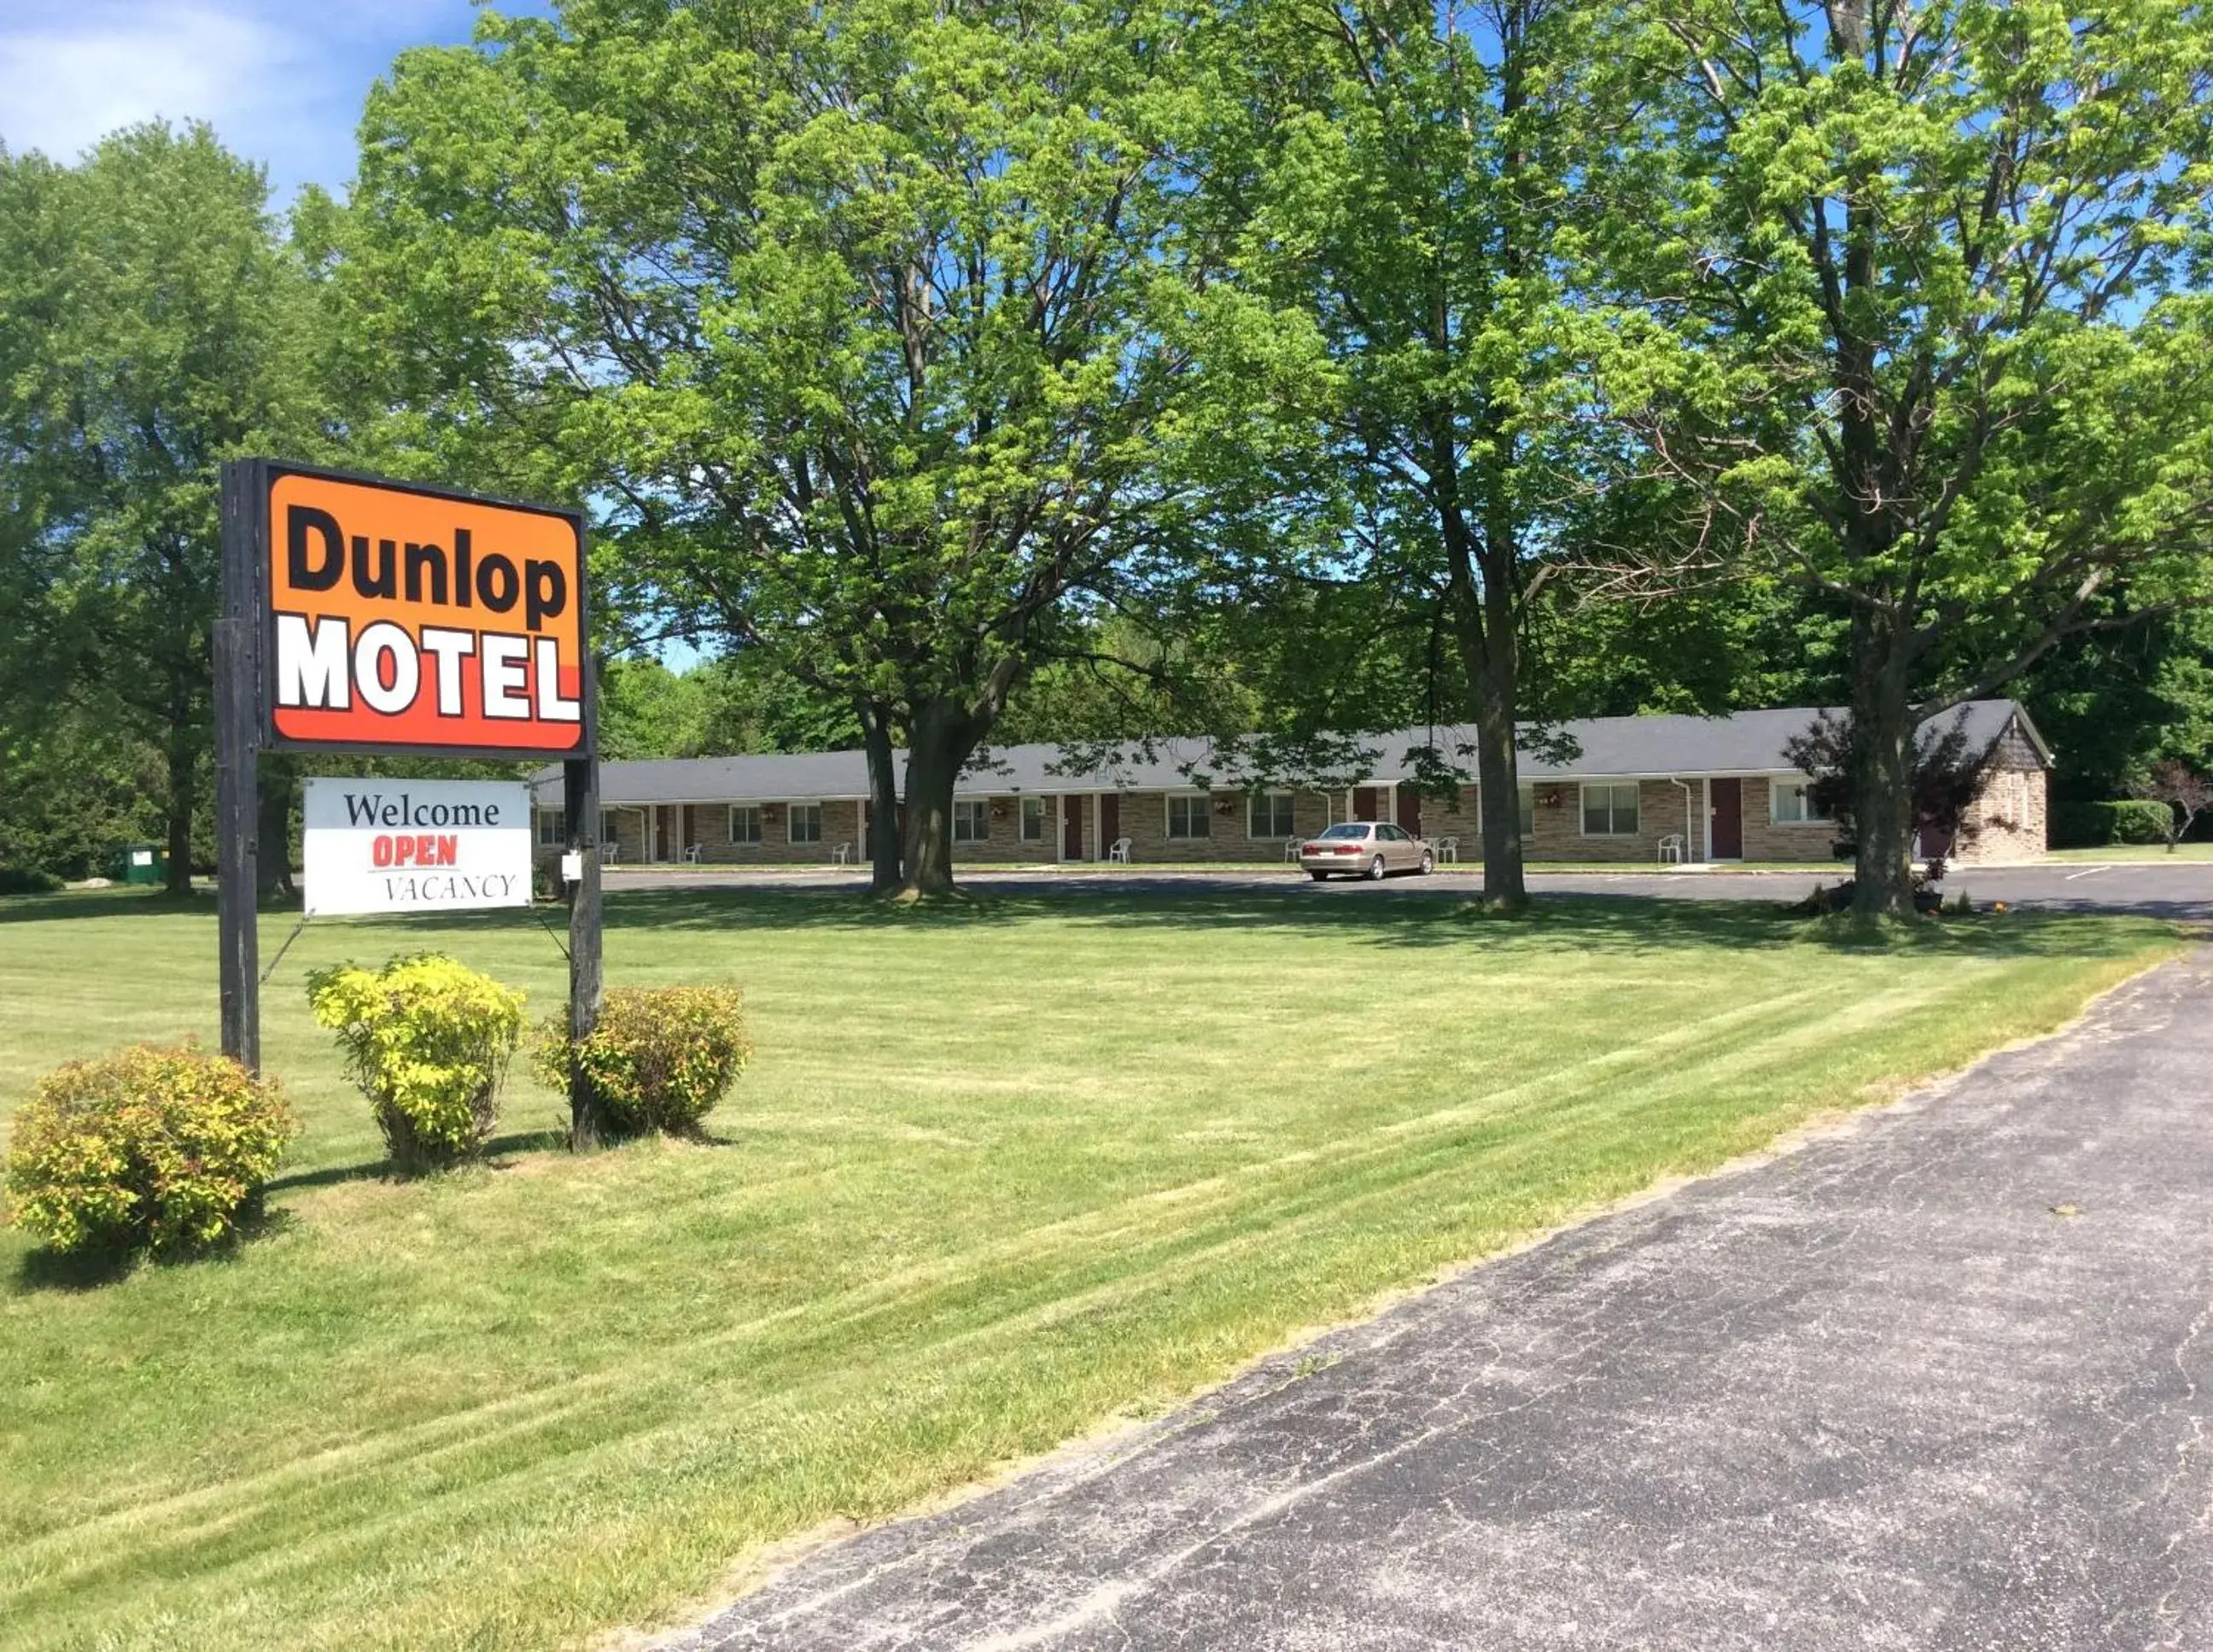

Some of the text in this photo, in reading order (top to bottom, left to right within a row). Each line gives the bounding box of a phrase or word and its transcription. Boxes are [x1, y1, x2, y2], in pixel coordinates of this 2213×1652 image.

[287, 504, 566, 631] Dunlop
[276, 612, 581, 721] MOTEL
[344, 794, 499, 827] Welcome
[371, 834, 458, 867] OPEN
[385, 874, 516, 902] VACANCY
